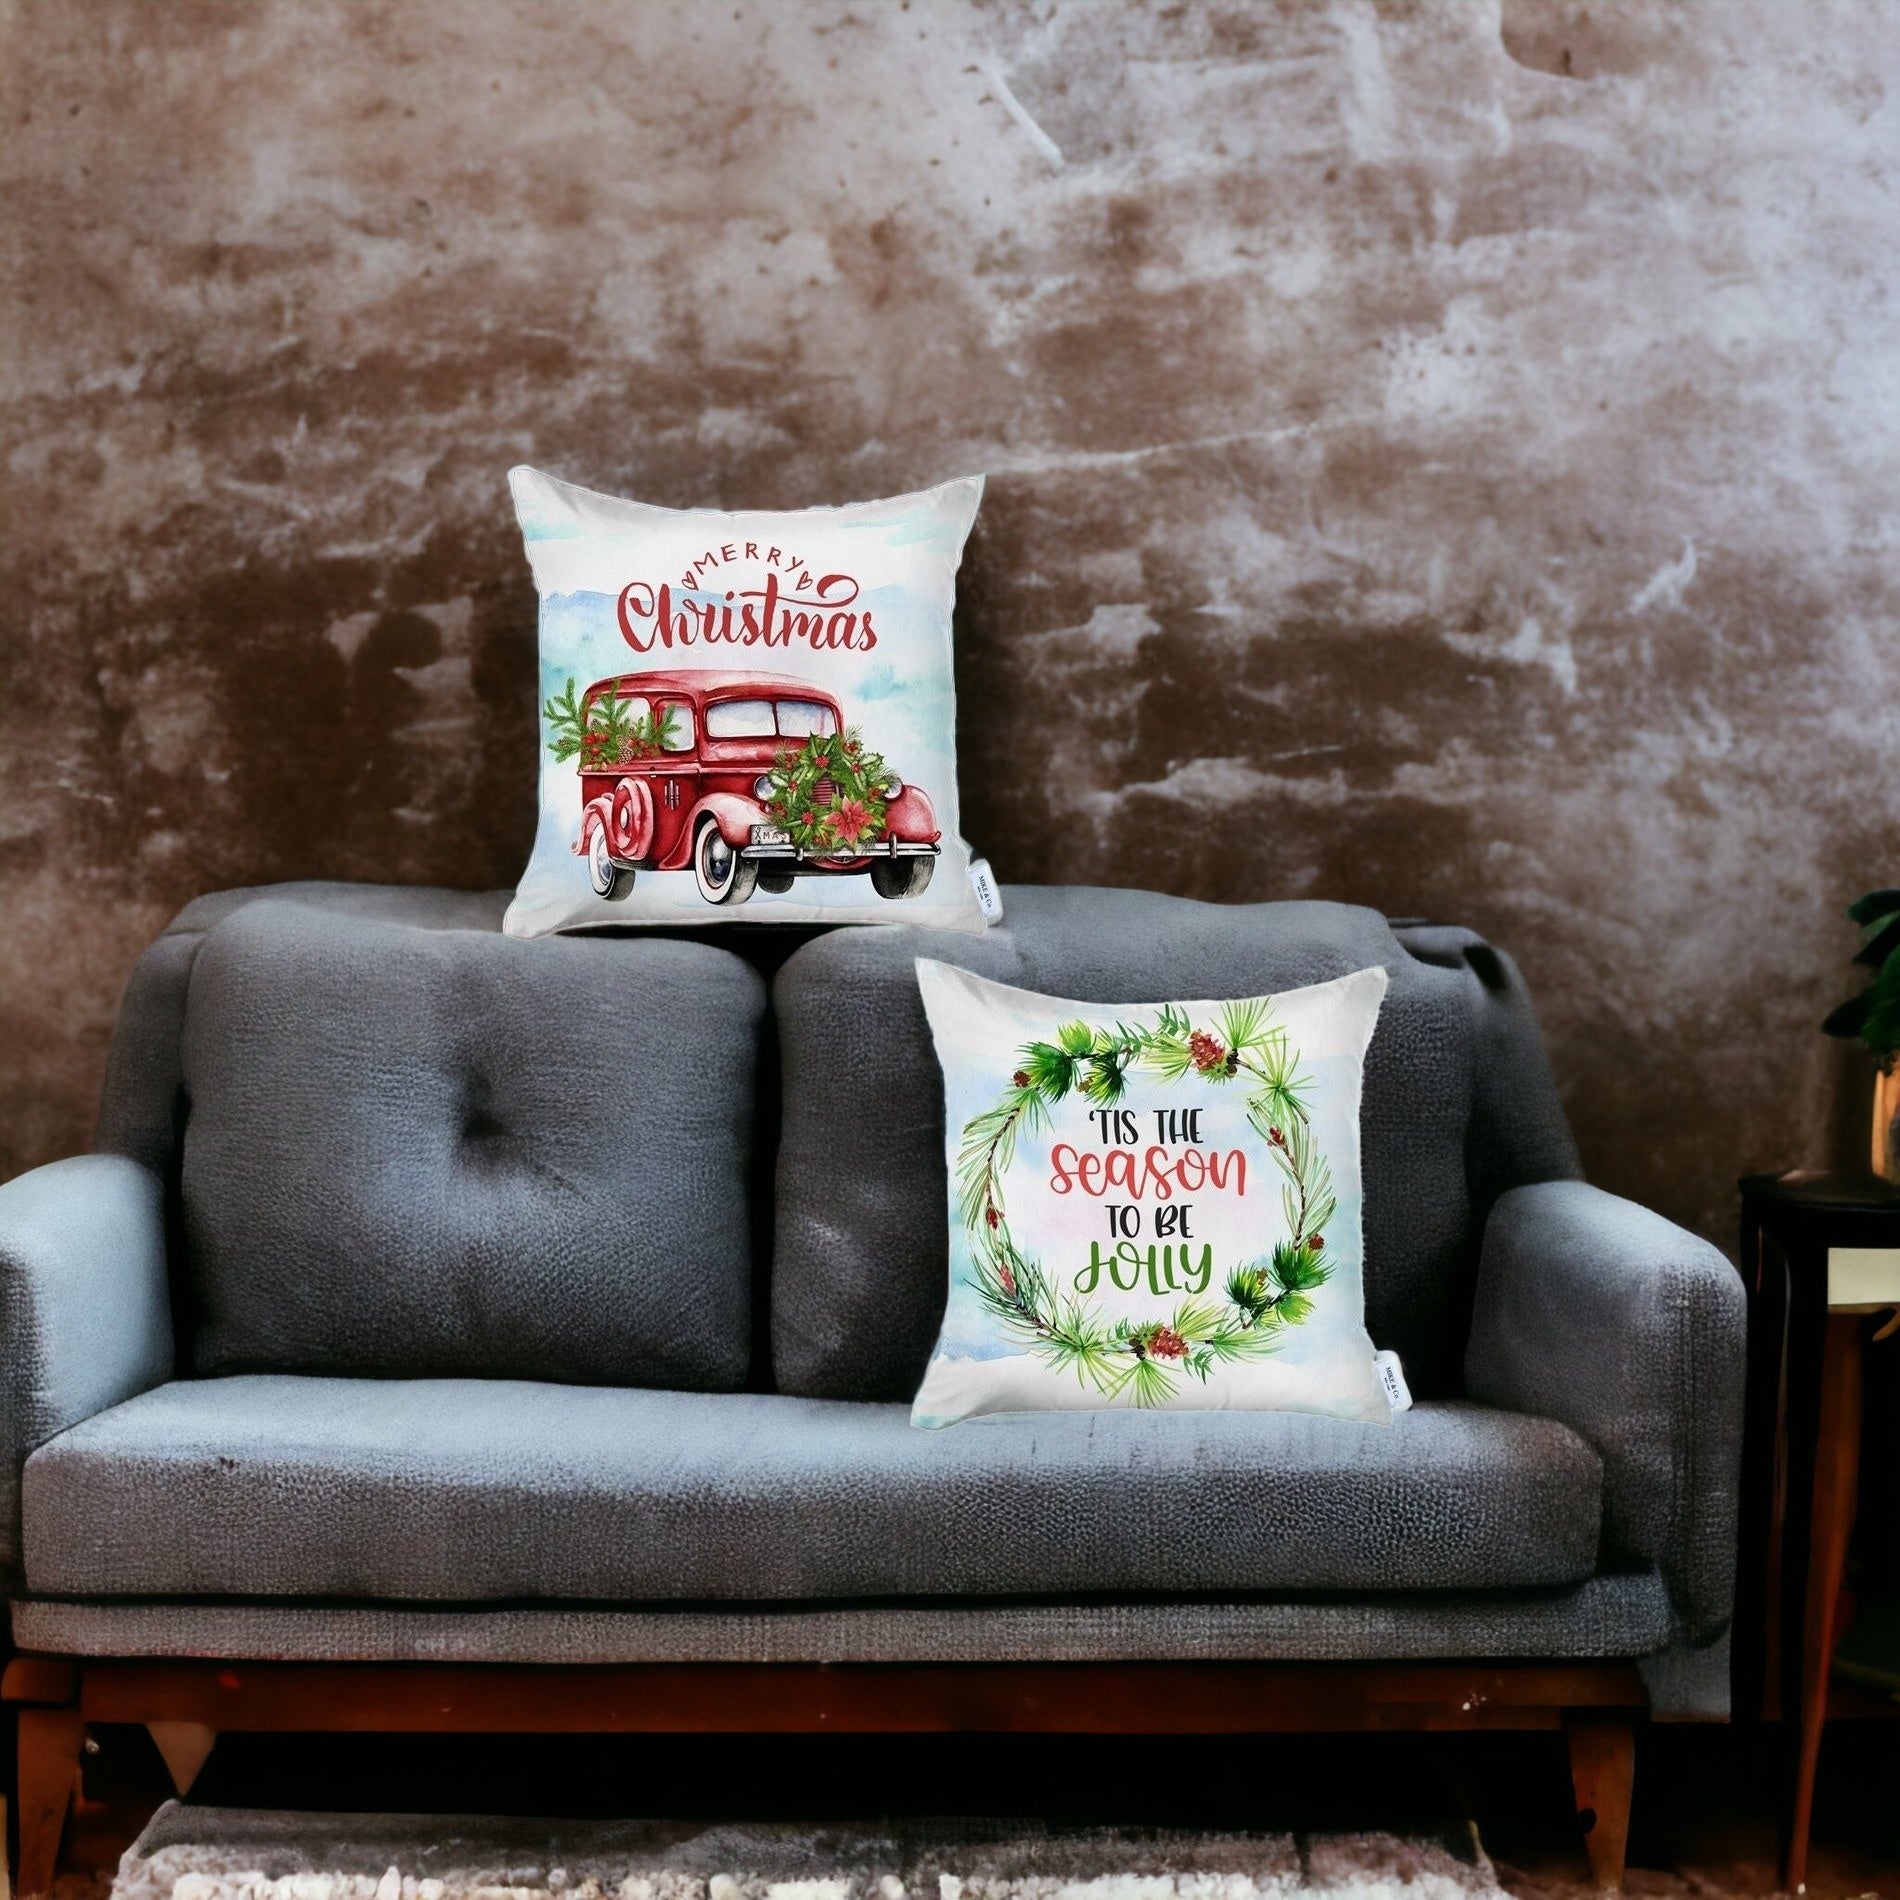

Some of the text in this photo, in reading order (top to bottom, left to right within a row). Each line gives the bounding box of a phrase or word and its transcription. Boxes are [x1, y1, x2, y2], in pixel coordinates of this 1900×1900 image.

[693, 542, 804, 575] MERRY
[617, 573, 878, 653] Christmas
[979, 875, 988, 892] MIKE
[1153, 1108, 1204, 1145] THE
[1050, 1143, 1246, 1200] season
[1104, 1204, 1194, 1239] TO BE
[1074, 1241, 1212, 1296] JOLLY
[1386, 1367, 1395, 1383] MIKE
